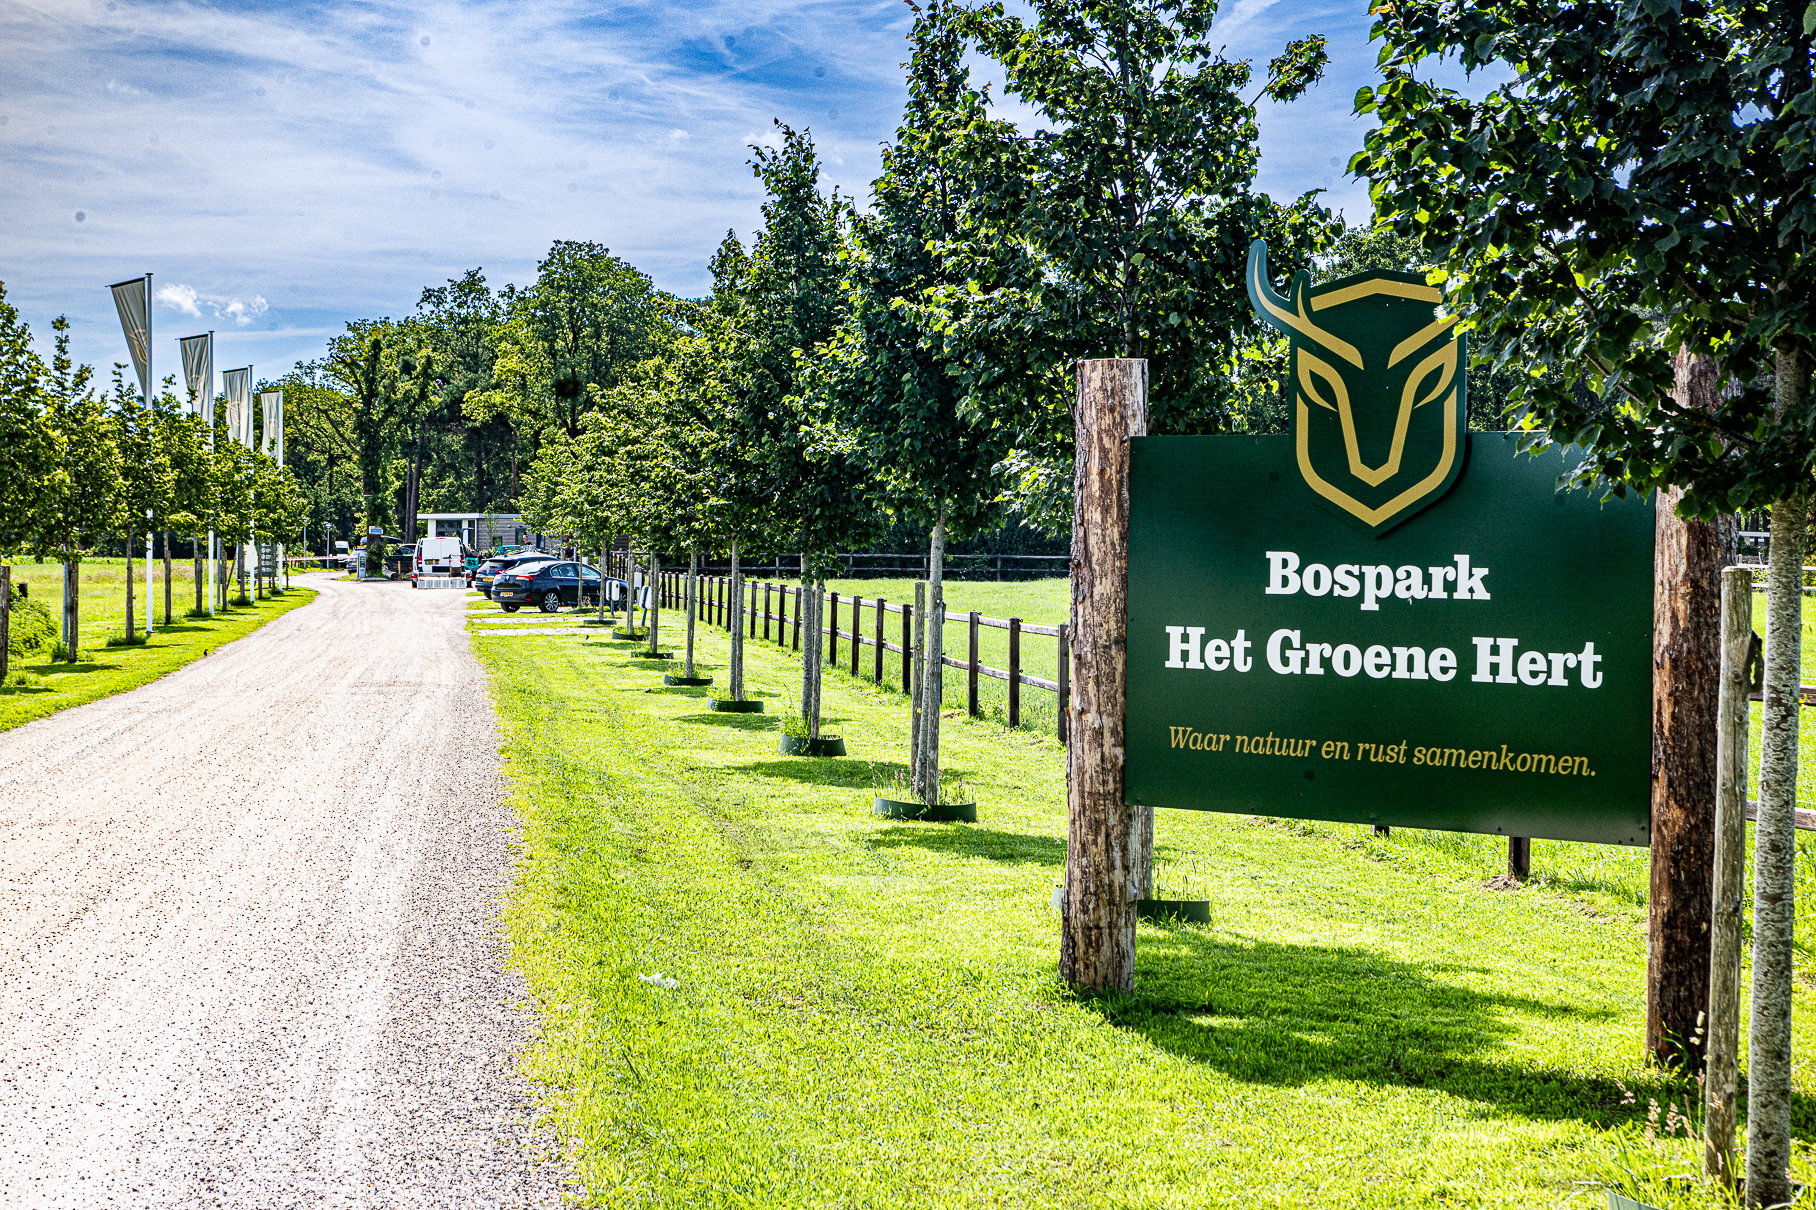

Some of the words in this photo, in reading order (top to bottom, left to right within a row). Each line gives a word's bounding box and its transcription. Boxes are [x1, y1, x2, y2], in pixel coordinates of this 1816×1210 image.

[1265, 551, 1490, 610] Bospark
[1165, 626, 1252, 672] Het
[1267, 629, 1457, 681] Groene
[1472, 637, 1602, 688] Hert
[1169, 726, 1230, 751] Waar
[1236, 732, 1316, 757] natuur
[1321, 741, 1350, 760] en
[1358, 740, 1407, 763] rust
[1413, 745, 1595, 776] samenkomen.
